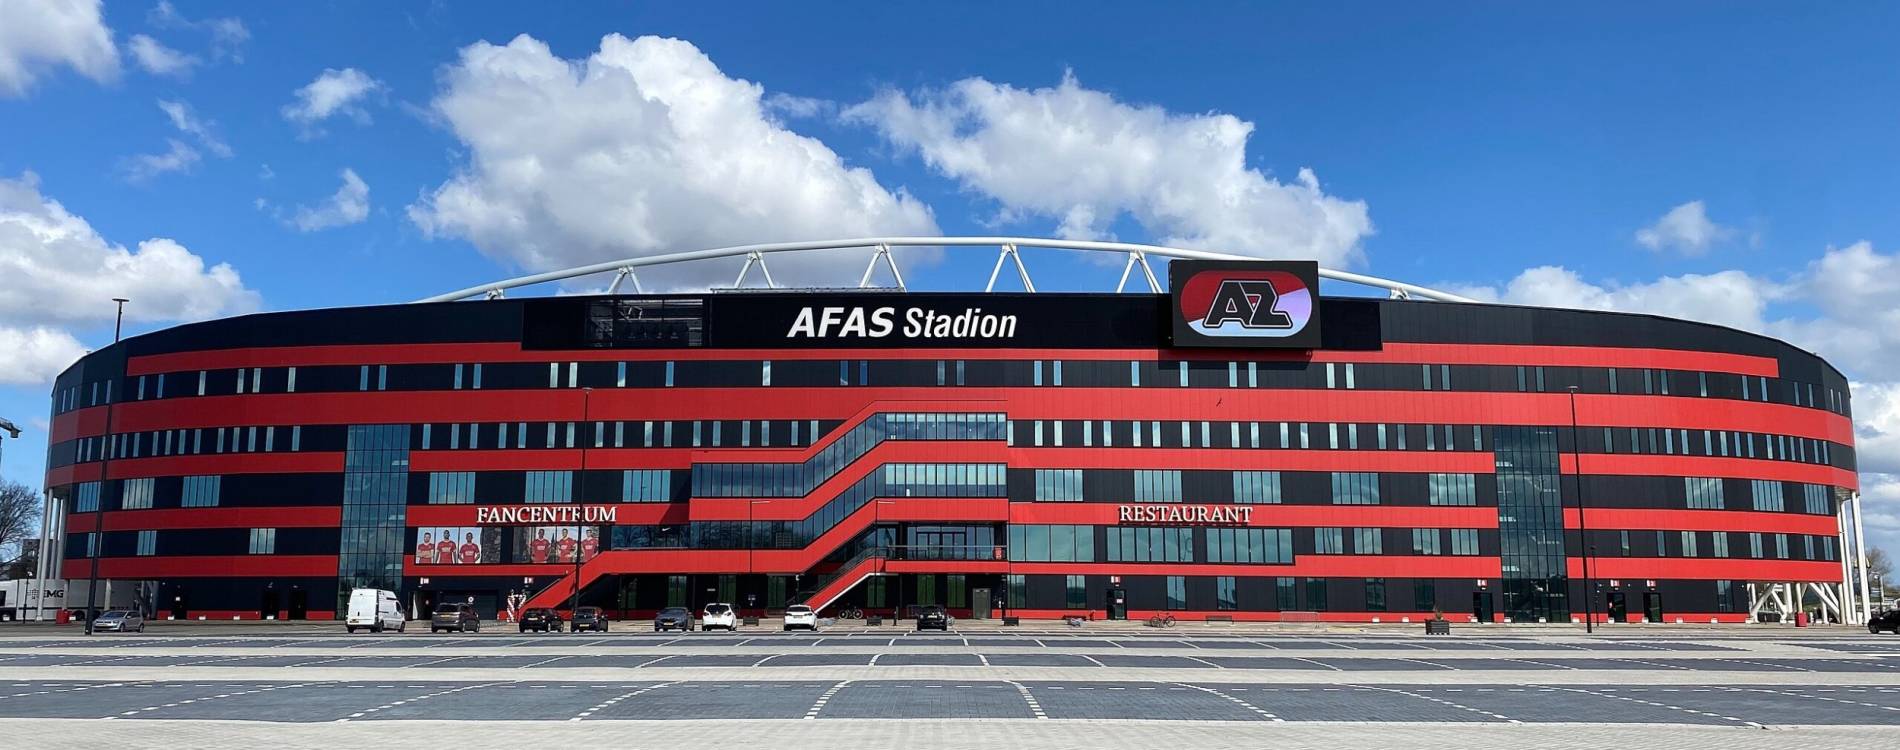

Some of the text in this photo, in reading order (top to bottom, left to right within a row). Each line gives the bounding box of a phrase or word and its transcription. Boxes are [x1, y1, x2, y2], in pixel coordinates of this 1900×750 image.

[1203, 280, 1293, 328] AZ
[786, 306, 1017, 338] AFAS Stadion
[476, 506, 617, 523] FANCENTRUM
[1119, 505, 1253, 523] RESTAURANT
